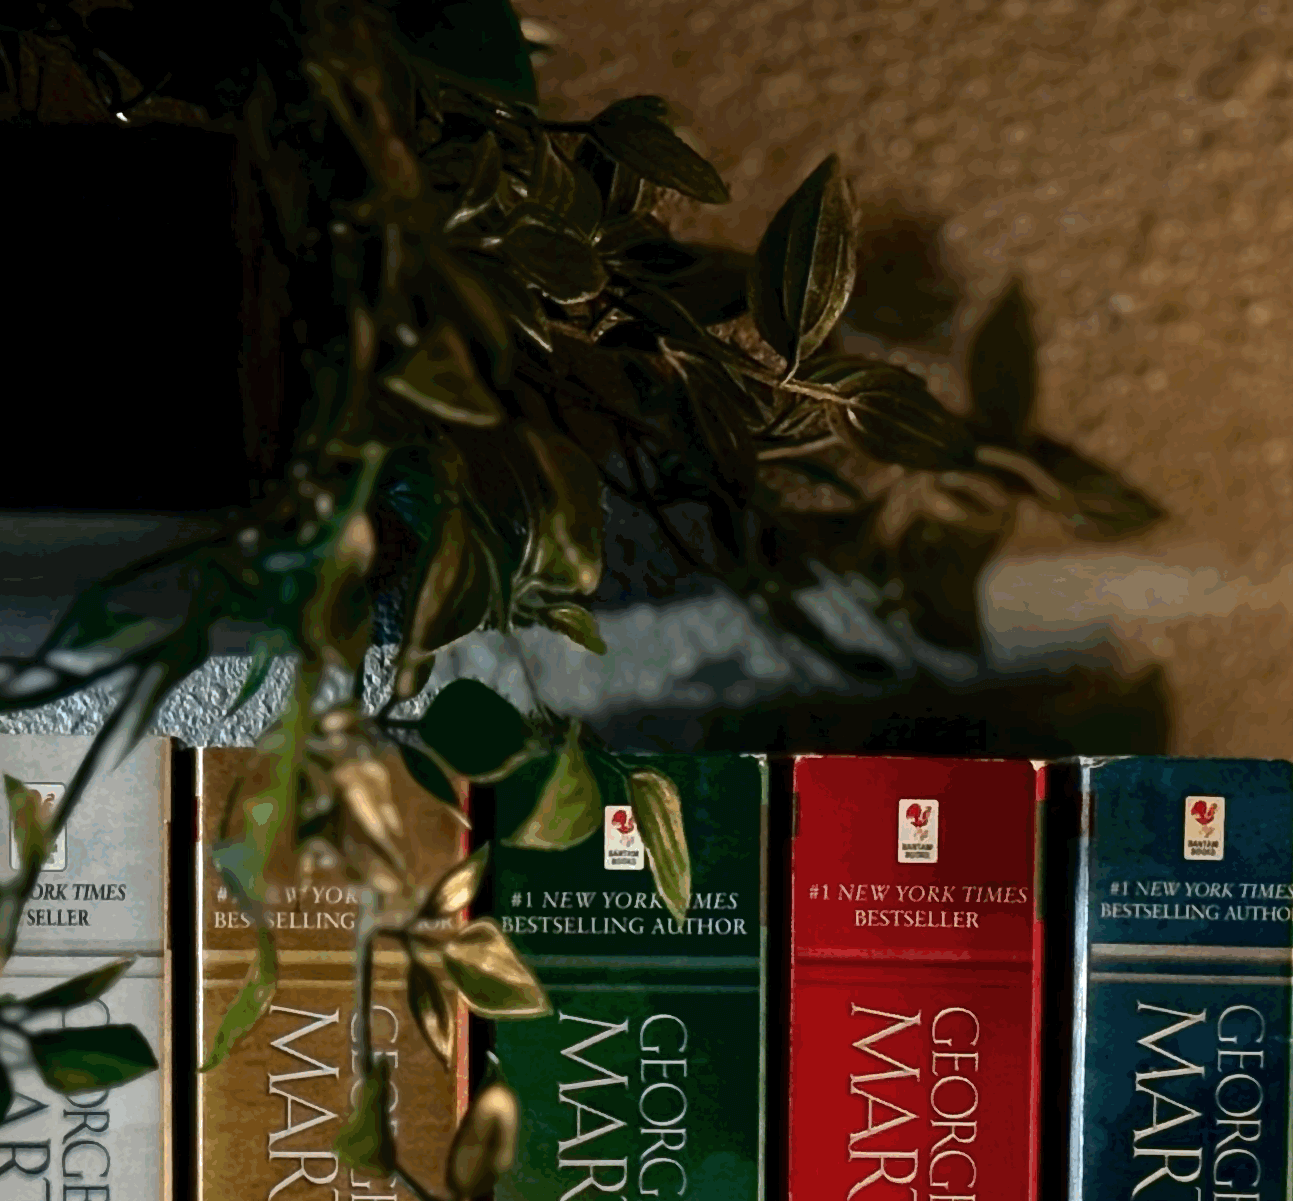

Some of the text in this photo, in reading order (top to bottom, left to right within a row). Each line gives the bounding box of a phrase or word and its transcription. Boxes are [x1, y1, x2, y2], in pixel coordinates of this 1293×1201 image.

[72, 883, 127, 901] TIMES
[809, 883, 1028, 904] #1 NEW YORK TIMES
[1110, 880, 1129, 897] #1
[1135, 880, 1180, 898] NEW
[1184, 881, 1233, 899] YORK
[511, 891, 533, 909] #1
[541, 891, 597, 909] NEW
[214, 911, 356, 930] BESSELLING
[854, 908, 980, 929] BESTSELLER
[1101, 903, 1219, 921] BESTSELLING
[501, 915, 748, 936] BESTSELLING AUTHOR
